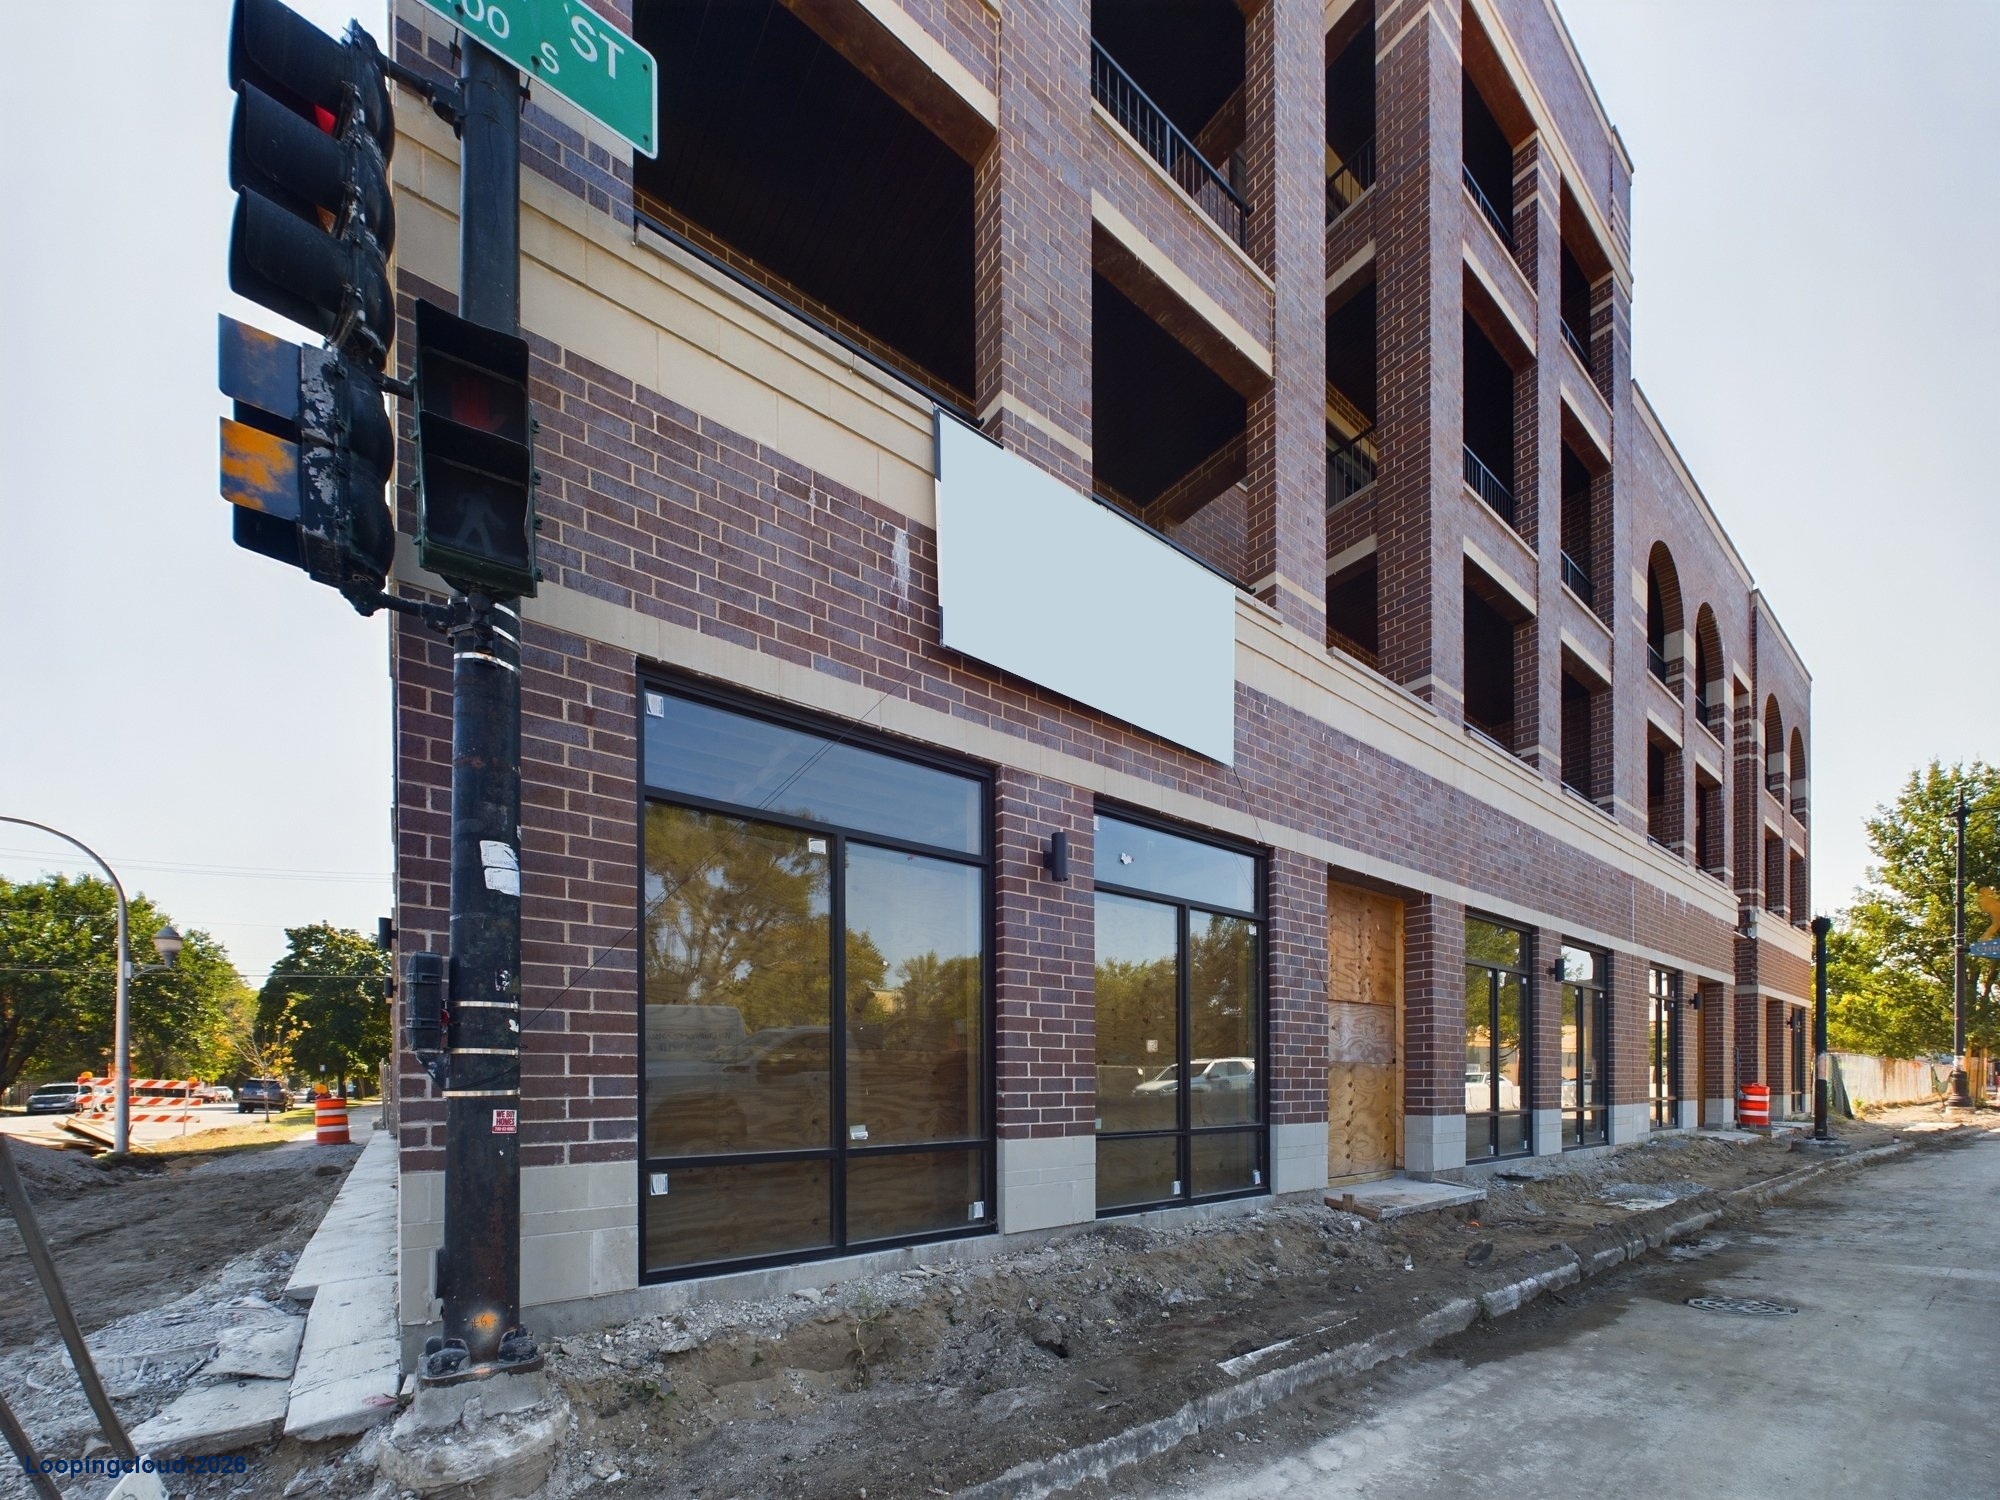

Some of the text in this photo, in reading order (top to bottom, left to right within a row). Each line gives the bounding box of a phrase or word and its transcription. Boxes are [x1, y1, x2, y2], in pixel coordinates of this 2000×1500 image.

[446, 0, 560, 74] 00 S
[570, 15, 625, 79] ST
